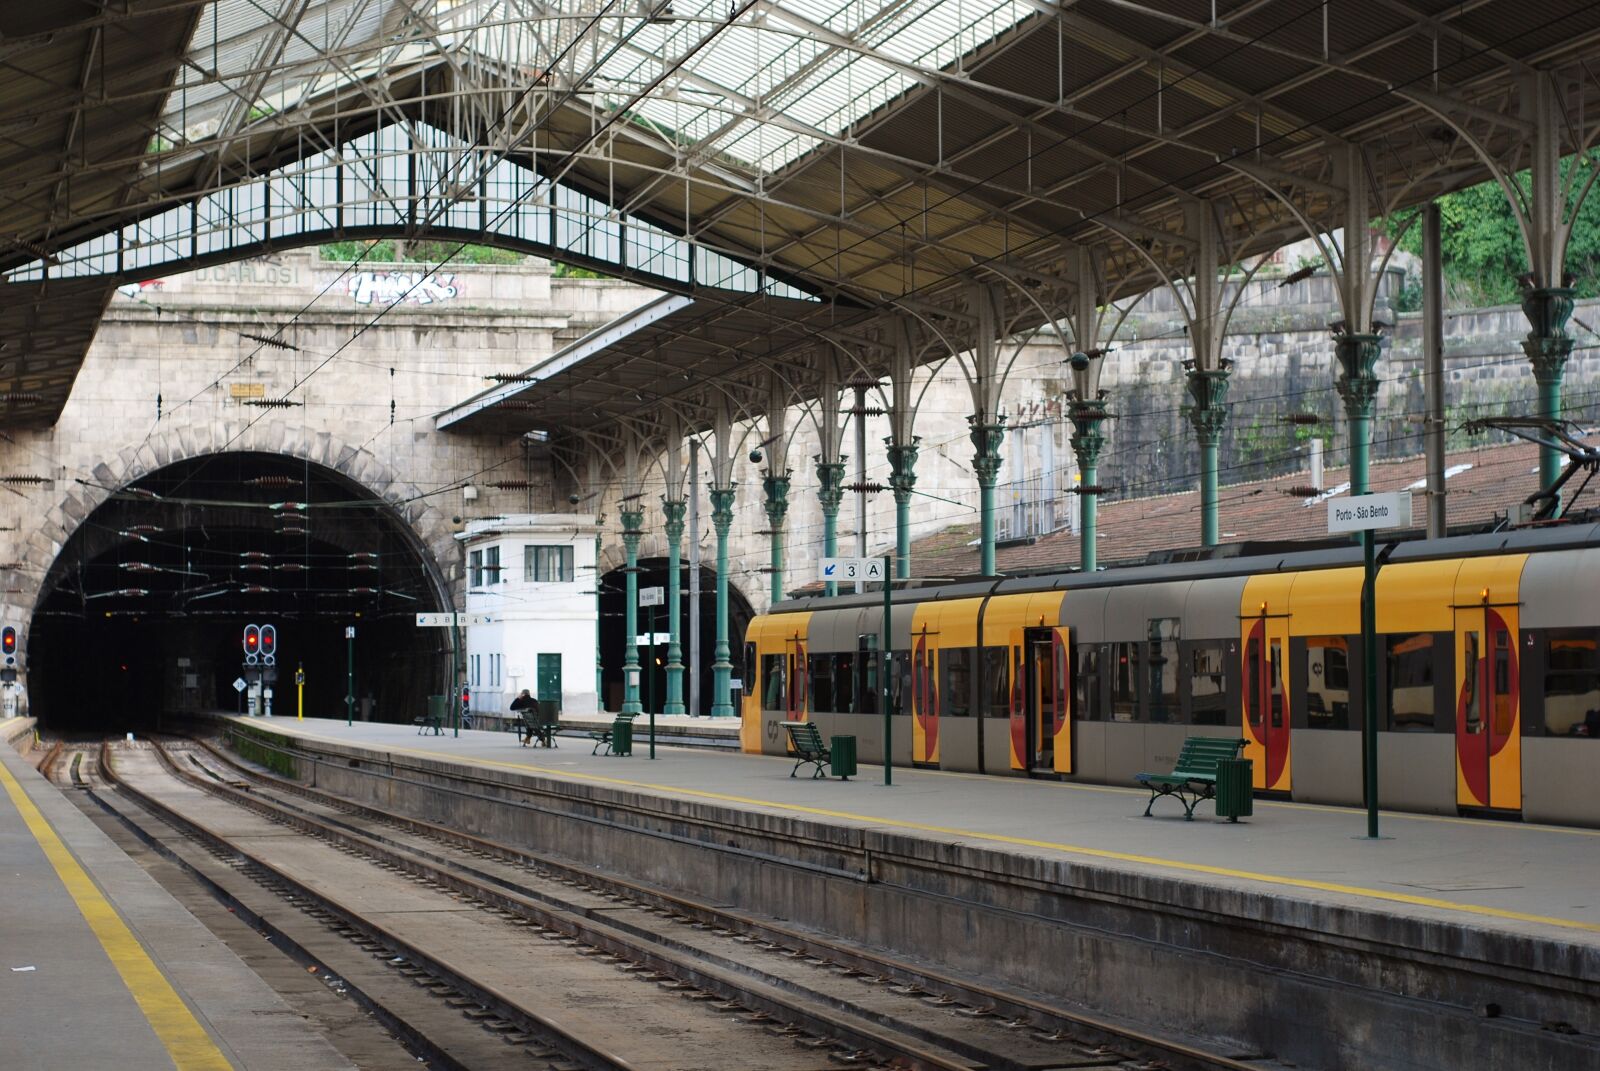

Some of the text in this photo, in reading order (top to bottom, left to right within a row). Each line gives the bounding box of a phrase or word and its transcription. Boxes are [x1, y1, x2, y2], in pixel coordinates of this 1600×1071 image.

[1336, 508, 1352, 521] Porto
[1356, 506, 1369, 519] São
[1370, 504, 1389, 518] Bento
[848, 564, 879, 577] 3 A
